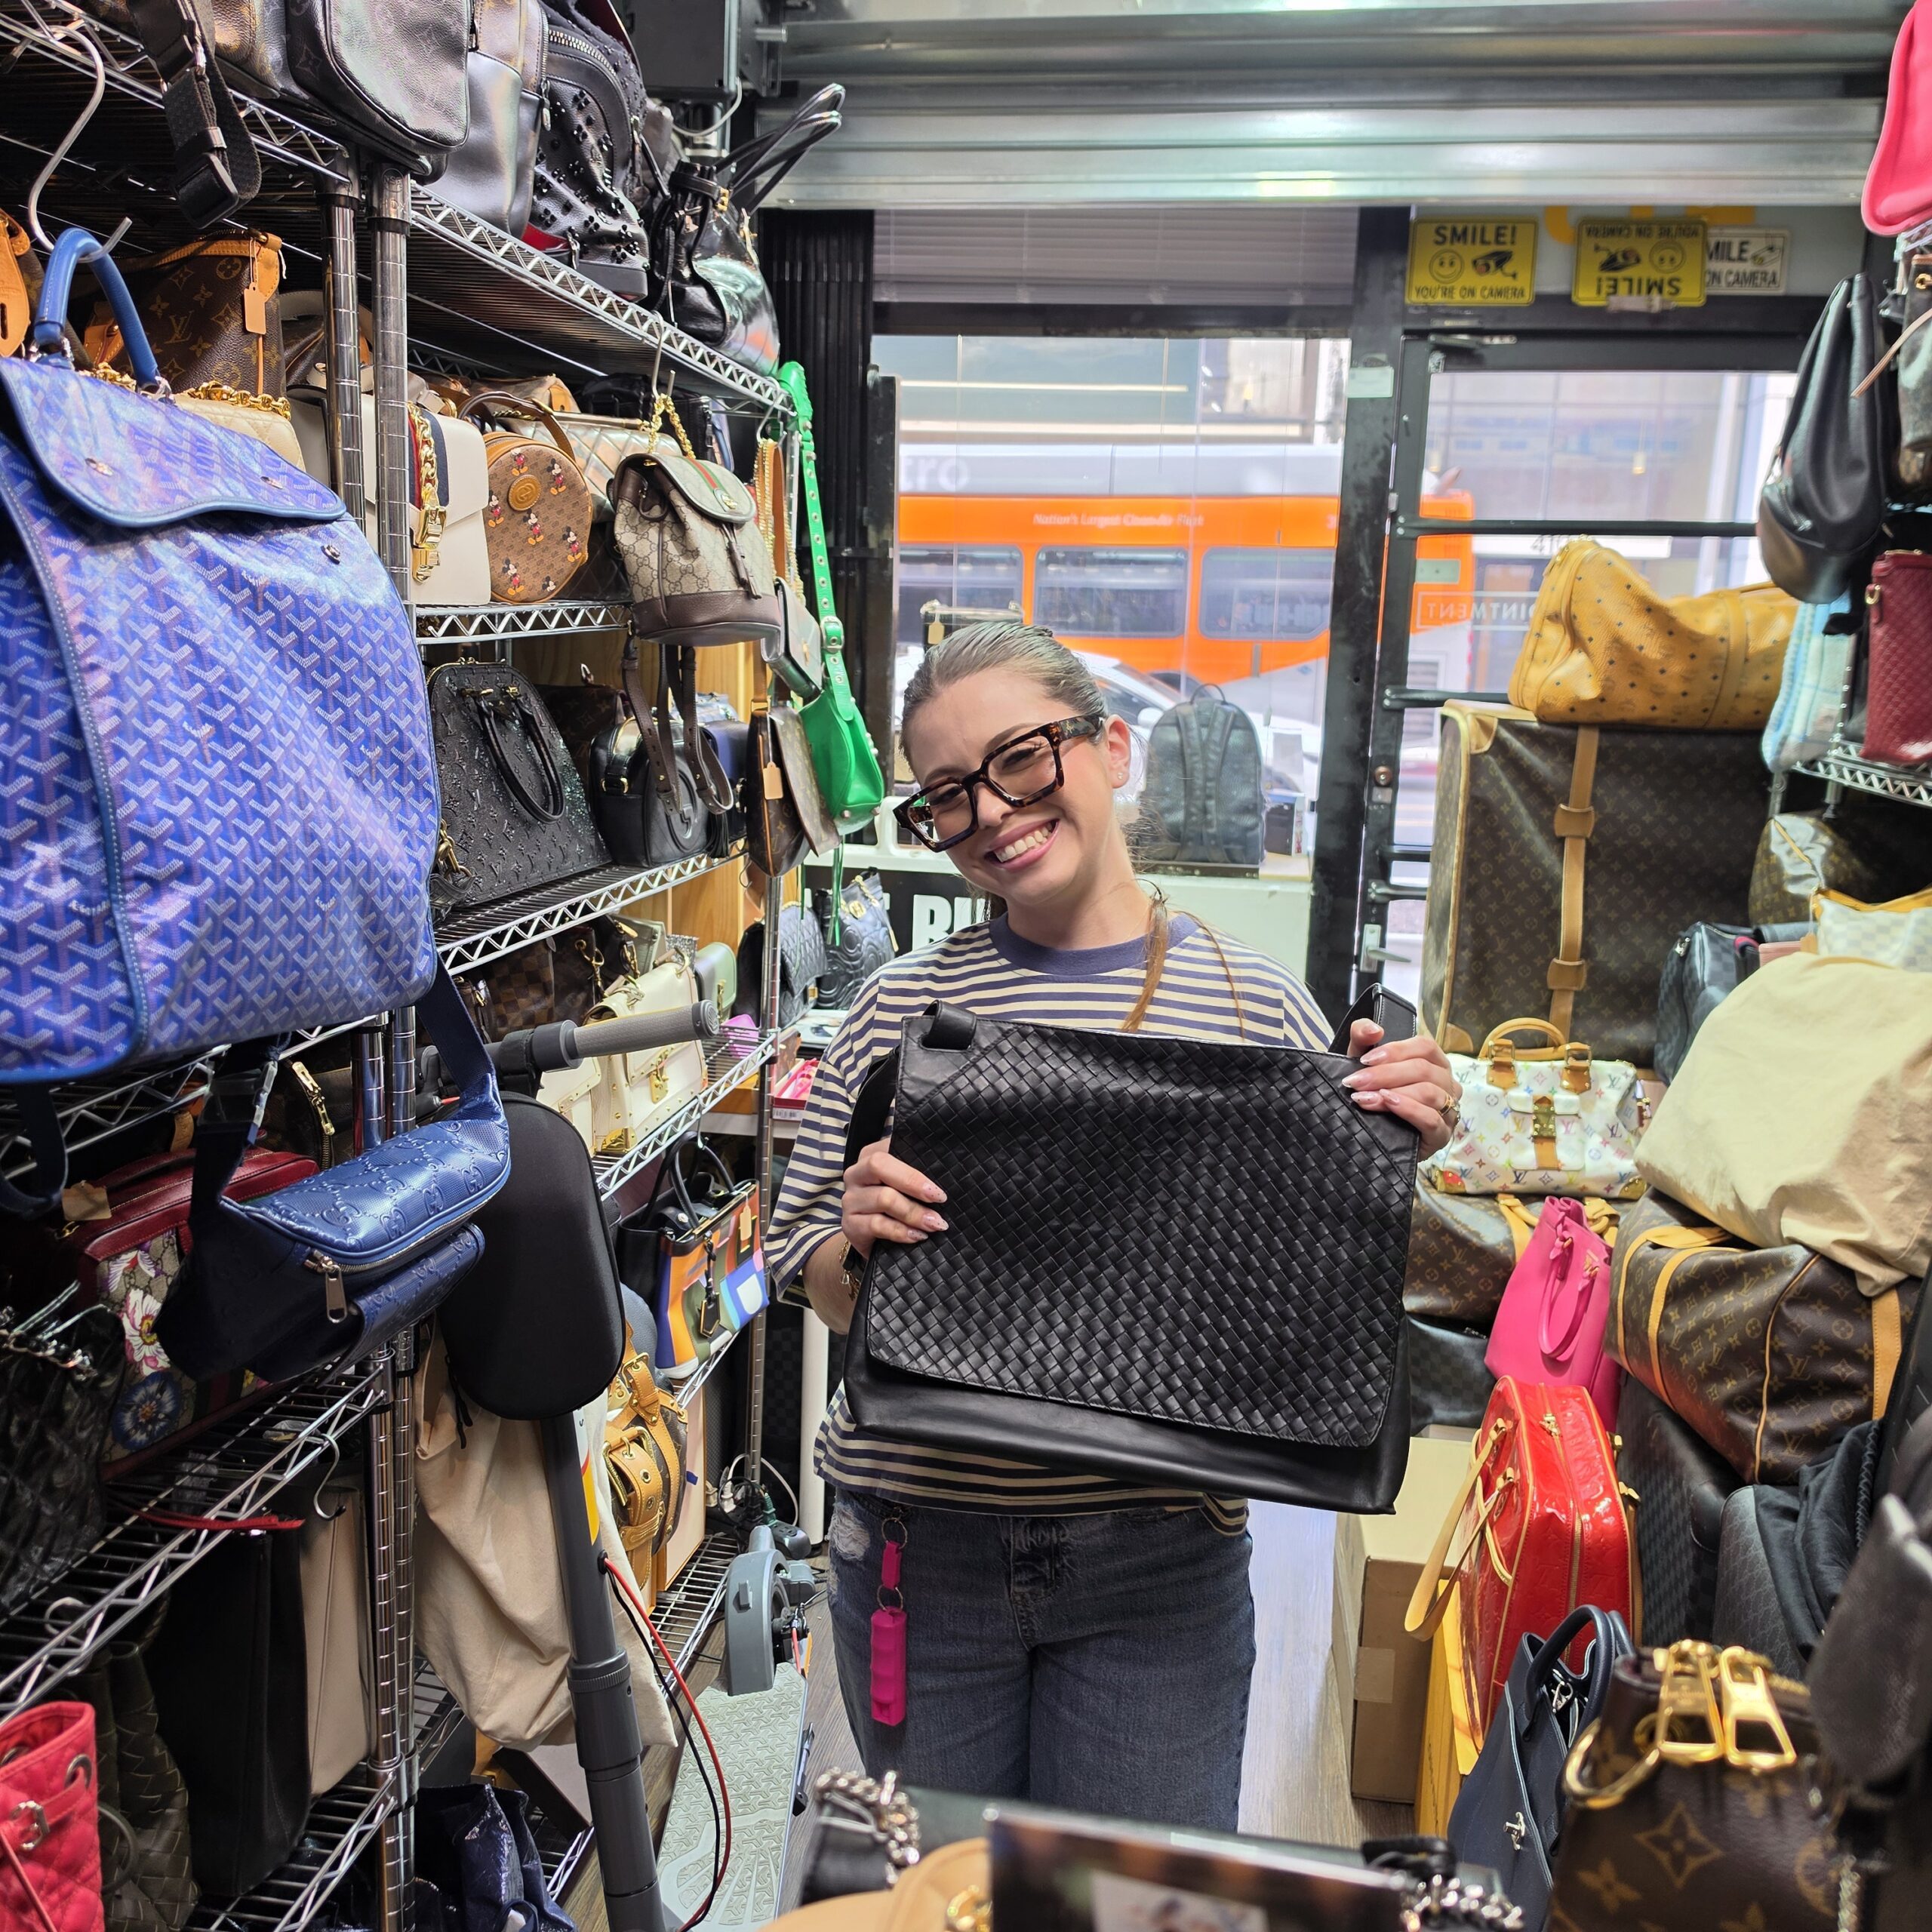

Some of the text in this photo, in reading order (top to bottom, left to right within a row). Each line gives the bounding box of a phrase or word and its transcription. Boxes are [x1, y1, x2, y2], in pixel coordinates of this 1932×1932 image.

[1433, 225, 1517, 246] SMILE!
[1595, 276, 1681, 296] SMILE!
[1724, 269, 1777, 287] CAMERA
[1414, 285, 1525, 300] YOU'RE ON CAMERA
